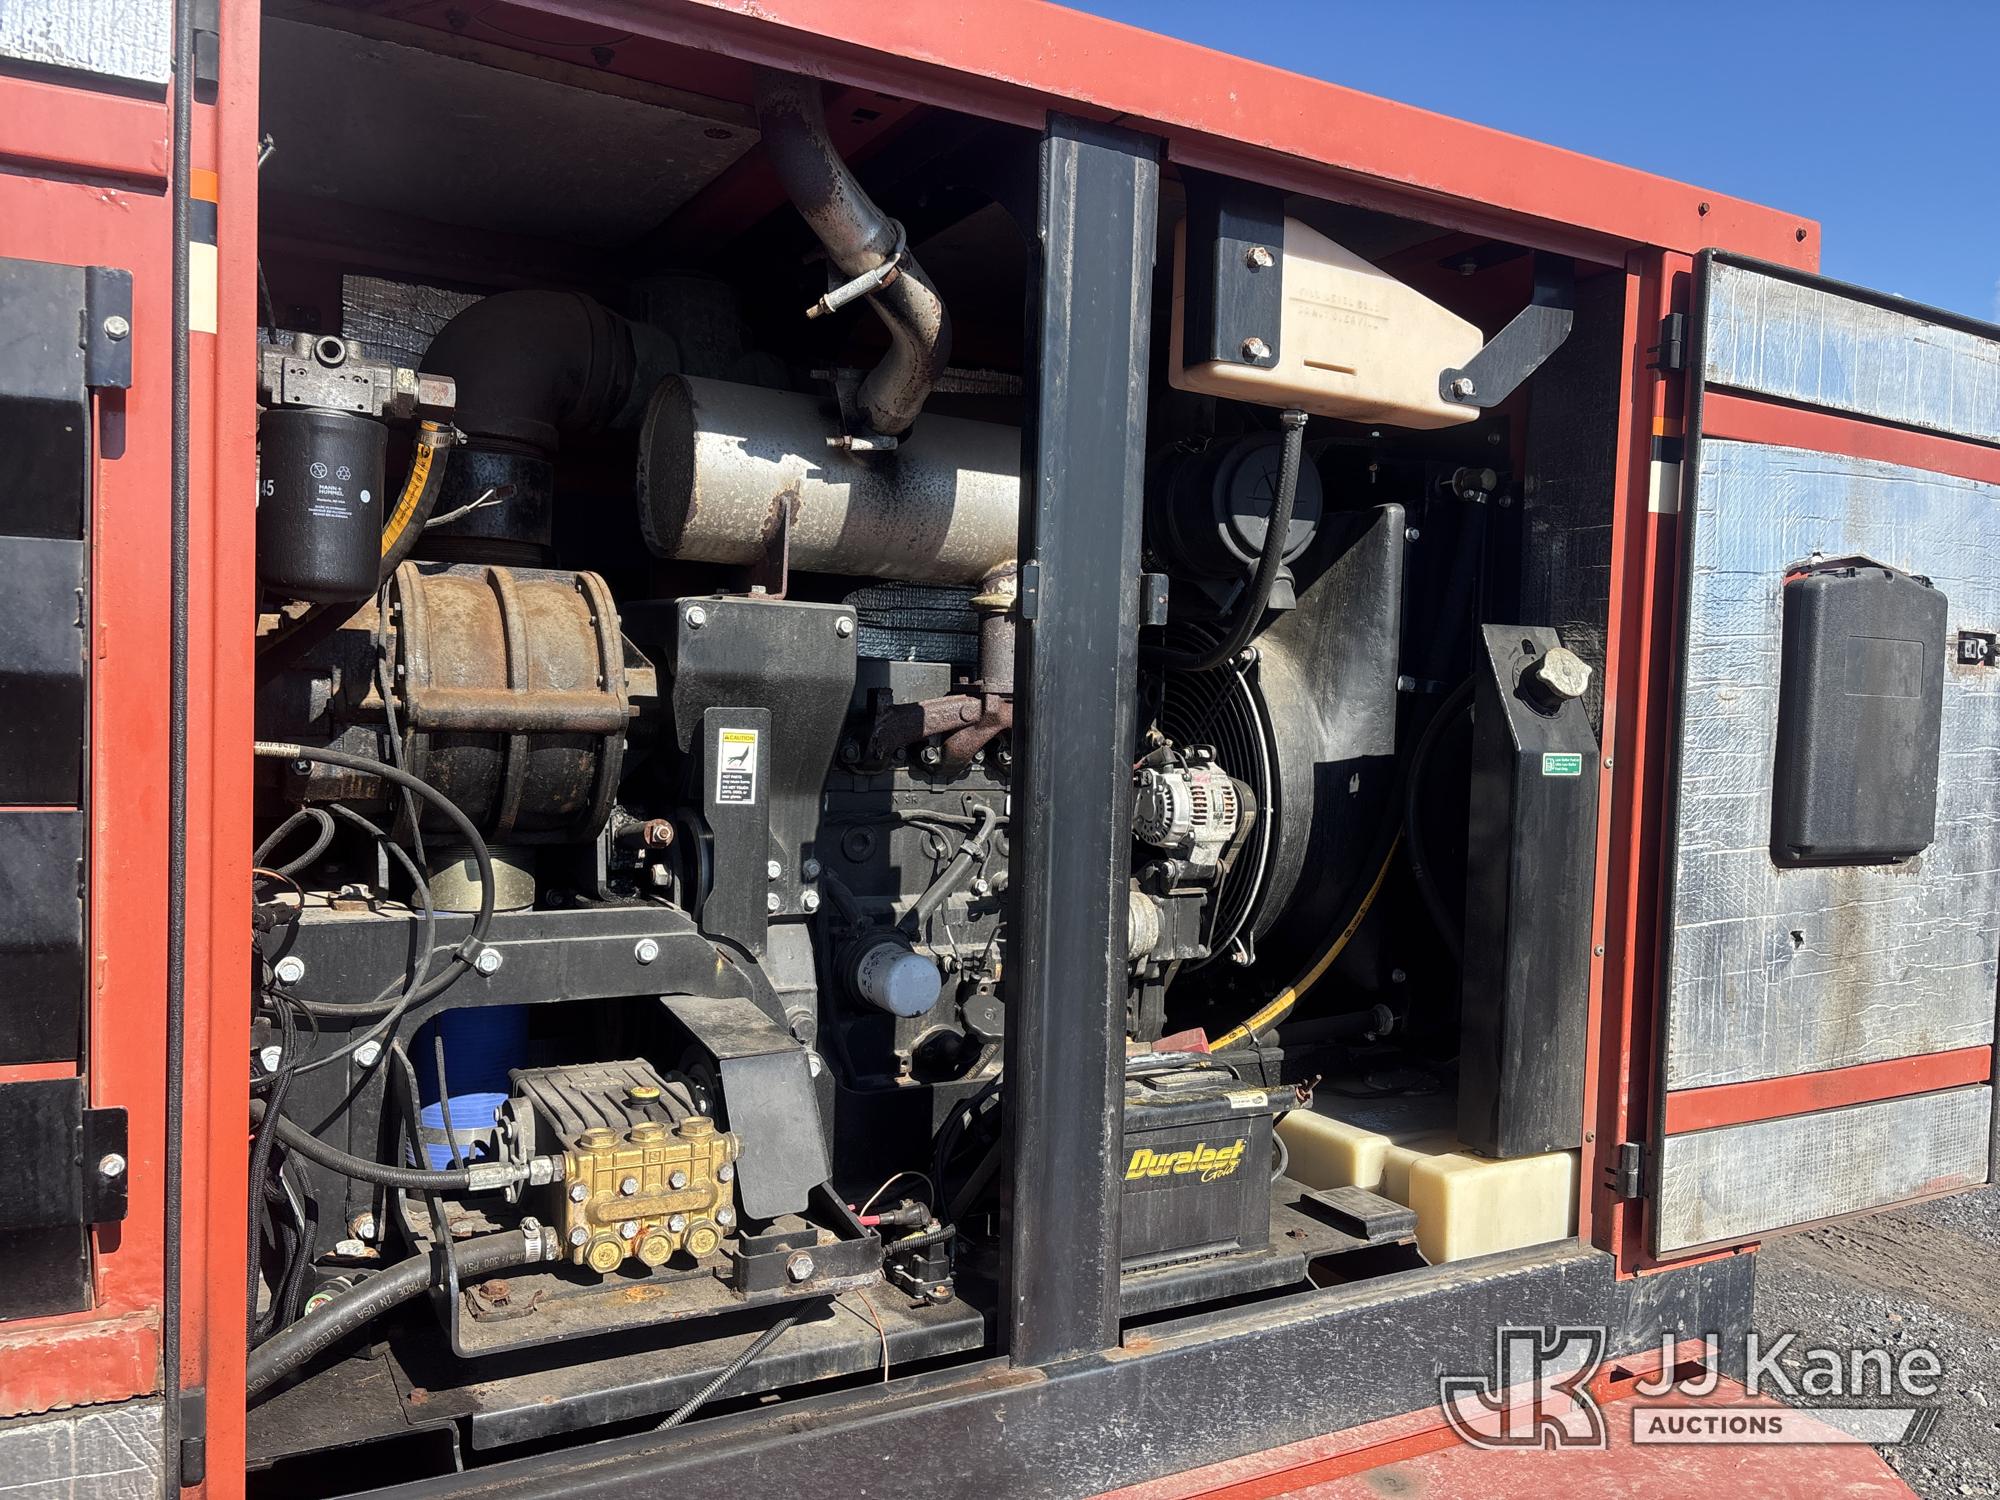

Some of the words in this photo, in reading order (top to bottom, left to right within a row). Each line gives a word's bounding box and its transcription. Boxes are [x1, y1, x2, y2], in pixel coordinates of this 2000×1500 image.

[1124, 1138, 1247, 1181] Duralast
[1201, 1159, 1240, 1183] Gold
[463, 1261, 479, 1273] PSI
[398, 1280, 420, 1298] MADE
[380, 1294, 392, 1308] IN
[356, 1303, 377, 1319] USA
[271, 1324, 344, 1377] ELECTRICALLY
